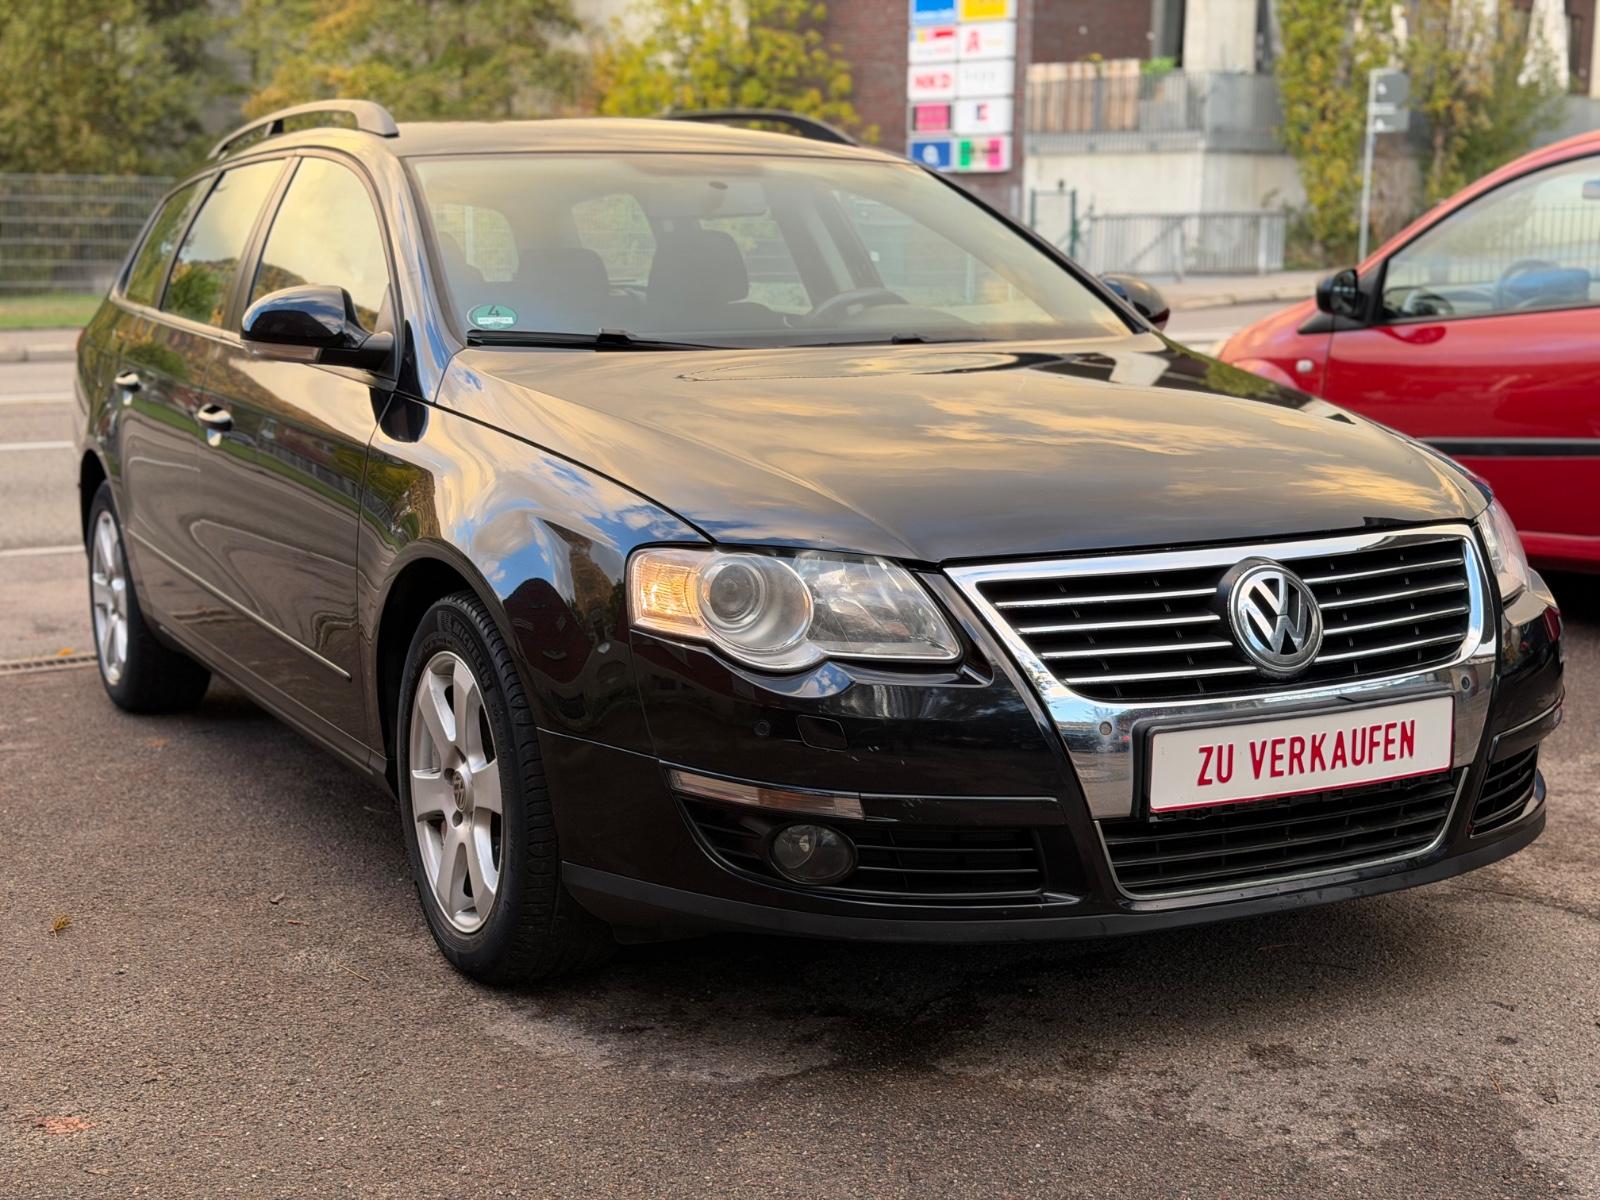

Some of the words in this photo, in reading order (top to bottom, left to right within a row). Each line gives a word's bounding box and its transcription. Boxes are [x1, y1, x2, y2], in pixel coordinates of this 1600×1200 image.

[488, 305, 500, 317] 4
[1233, 567, 1319, 666] VW
[1197, 744, 1234, 787] ZU
[1250, 719, 1416, 780] VERKAUFEN
